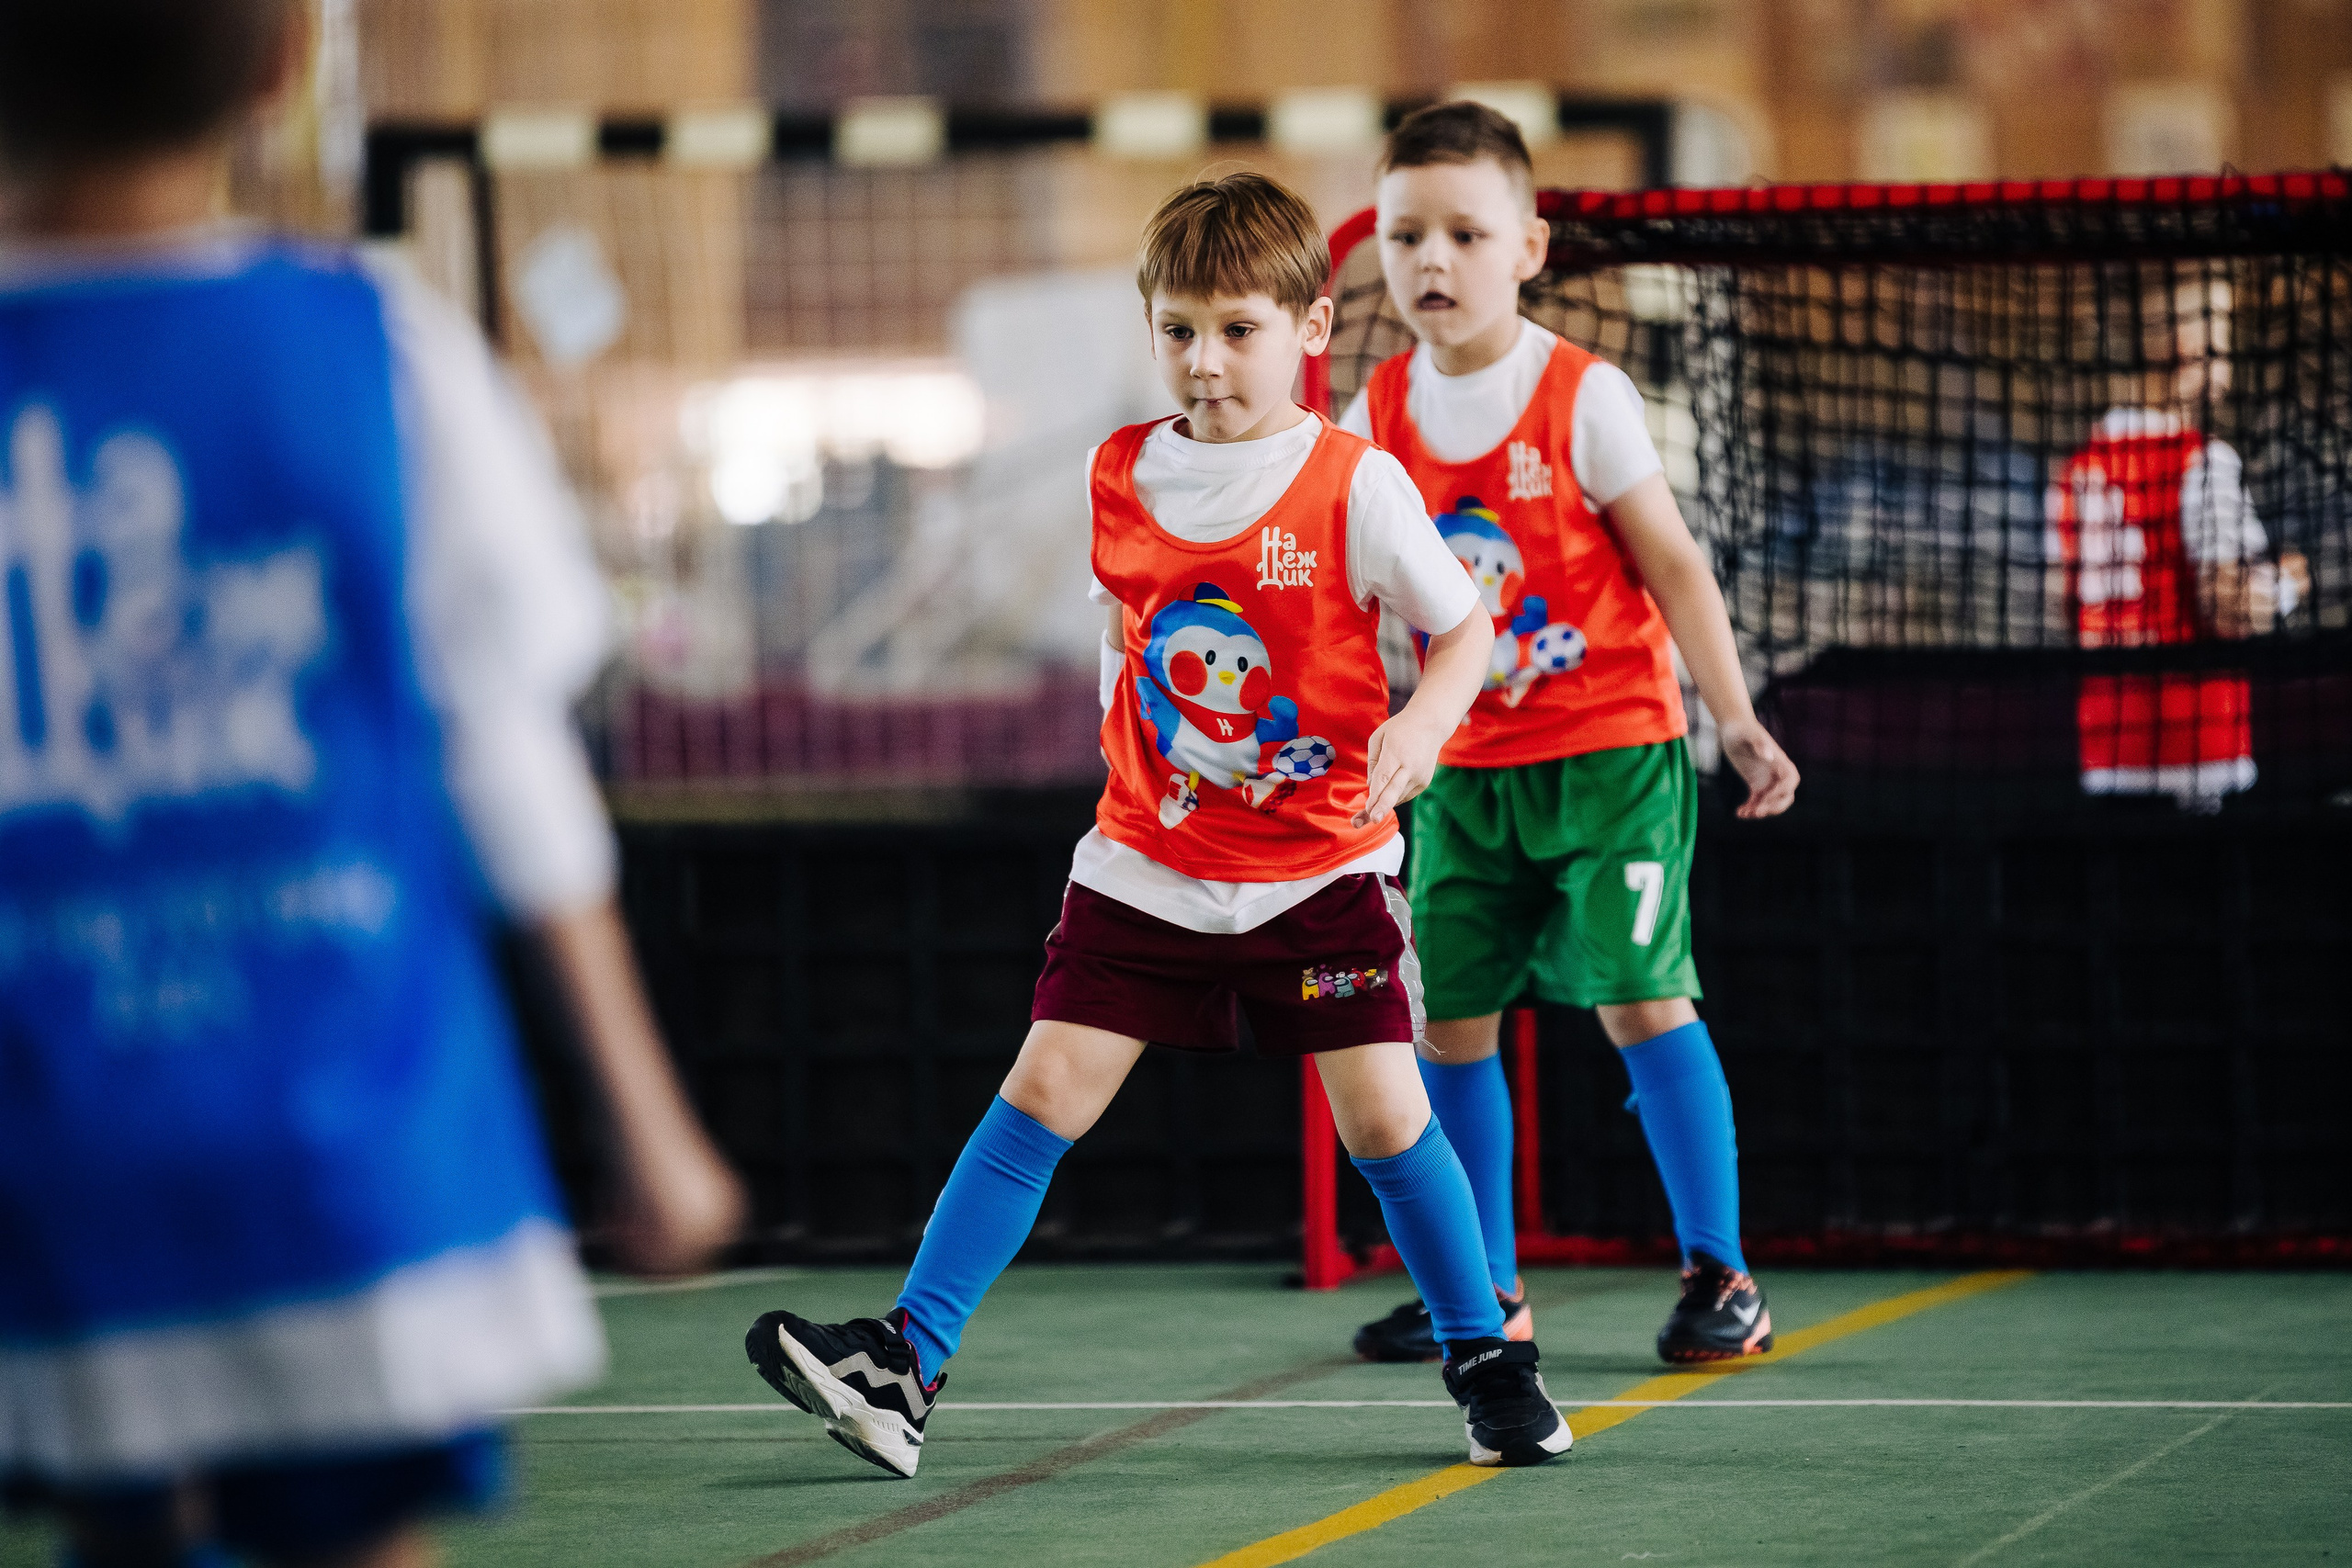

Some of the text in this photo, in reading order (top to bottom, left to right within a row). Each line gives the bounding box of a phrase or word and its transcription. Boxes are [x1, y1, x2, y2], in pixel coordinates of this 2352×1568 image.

[1624, 861, 1664, 946] 7
[1458, 1348, 1502, 1375] TIME JUMP
